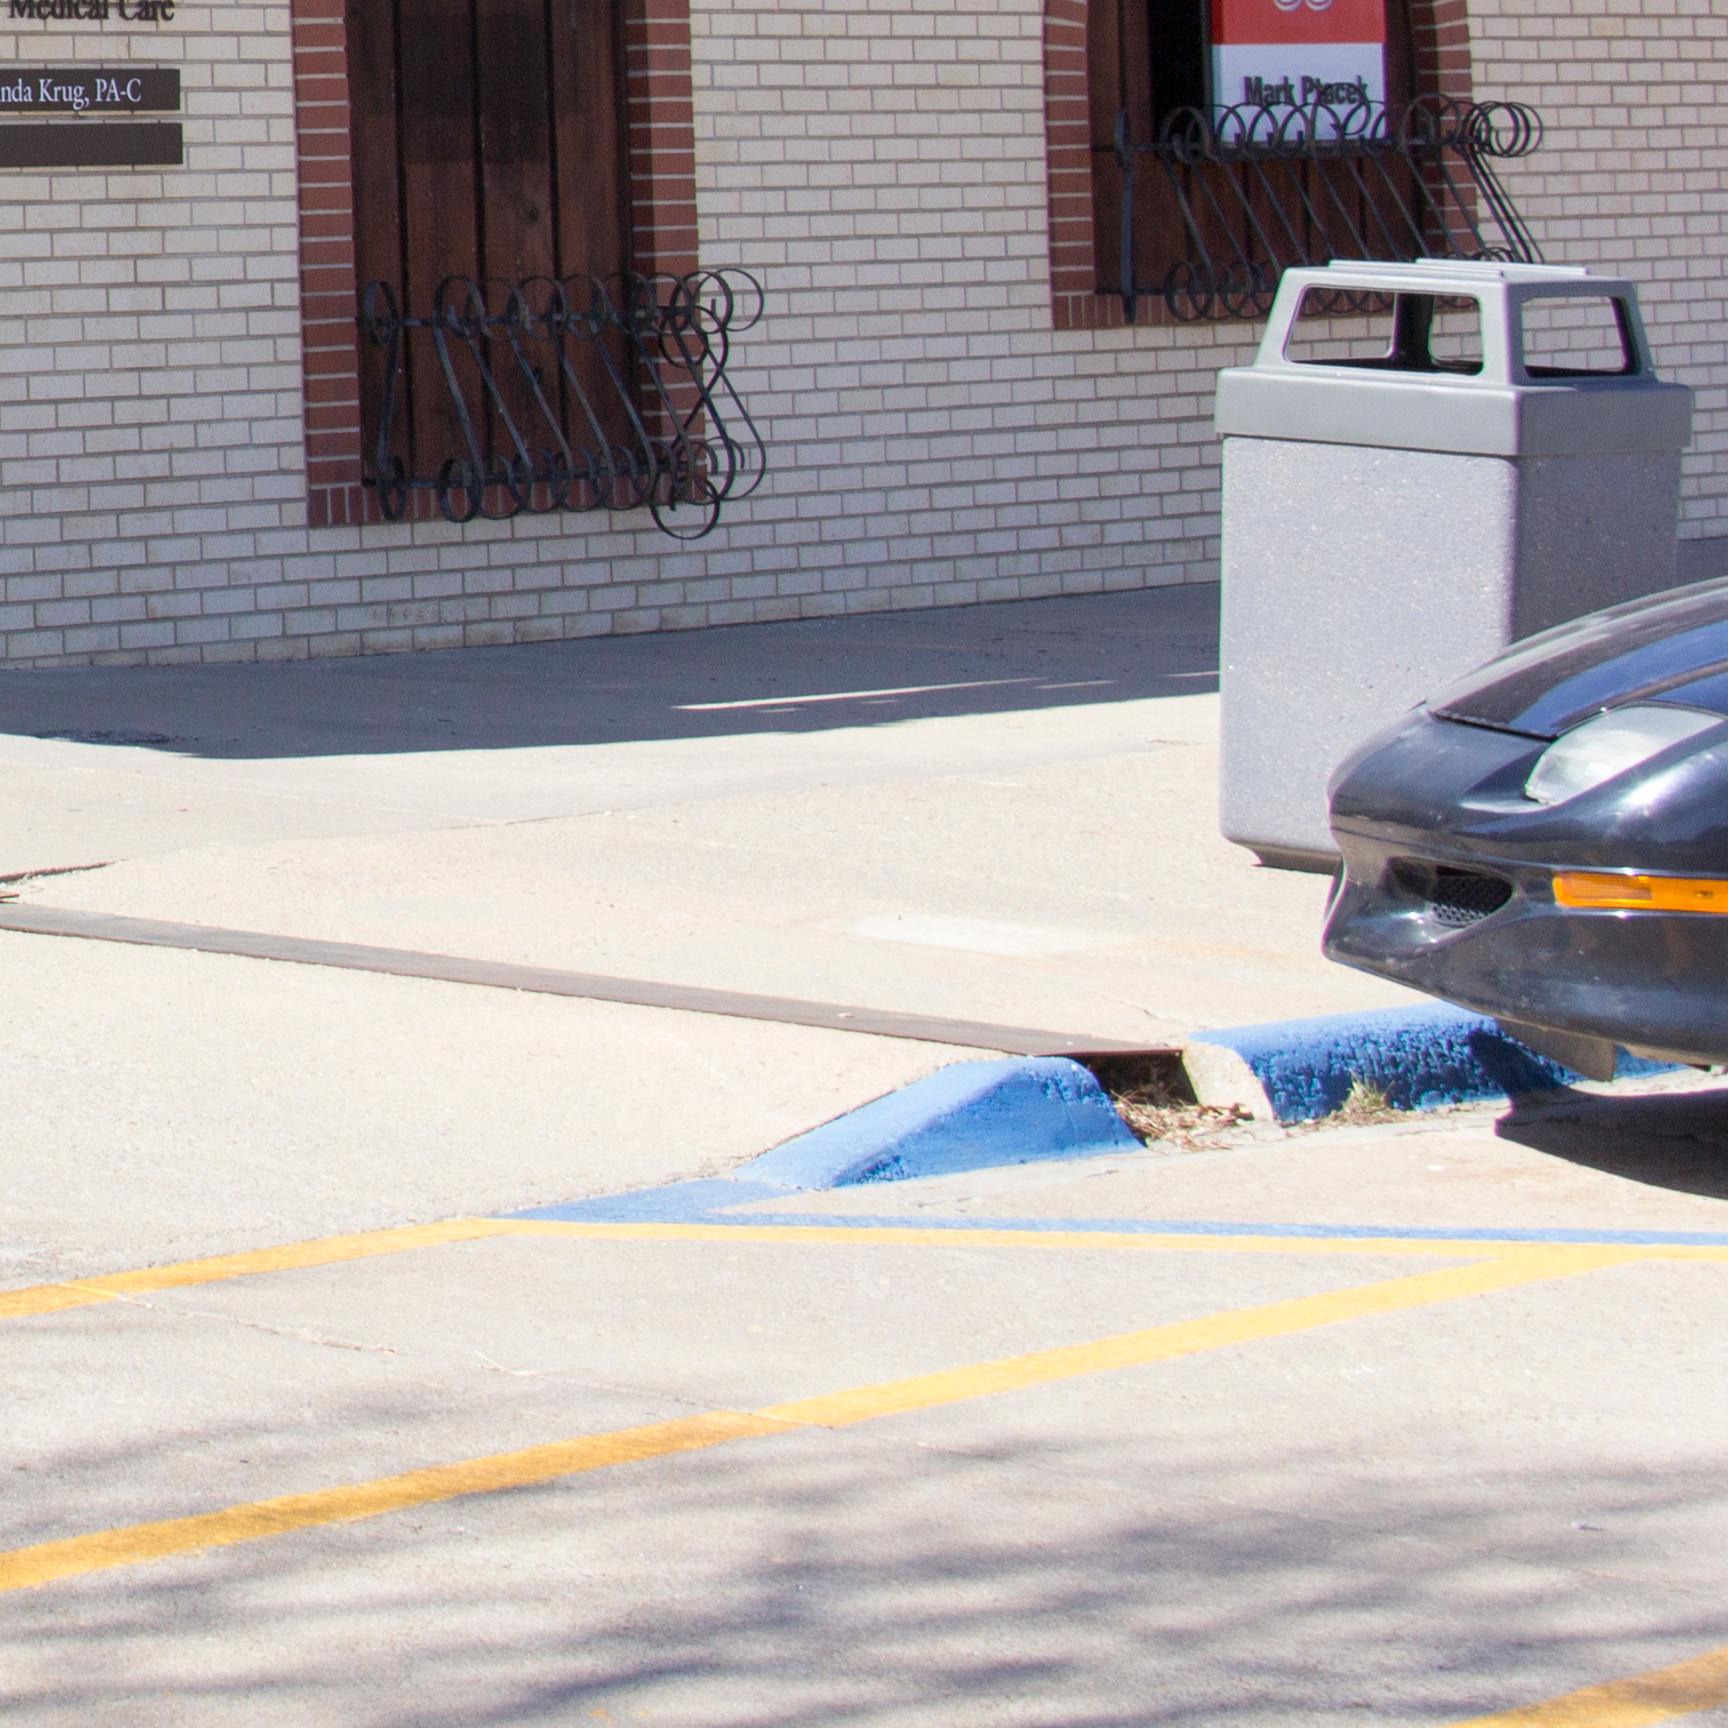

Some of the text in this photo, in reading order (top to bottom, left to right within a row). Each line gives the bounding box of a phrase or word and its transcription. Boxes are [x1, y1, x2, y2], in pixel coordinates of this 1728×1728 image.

[38, 78, 90, 111] Krug,
[95, 77, 142, 103] PA-C
[1243, 74, 1295, 106] Mark
